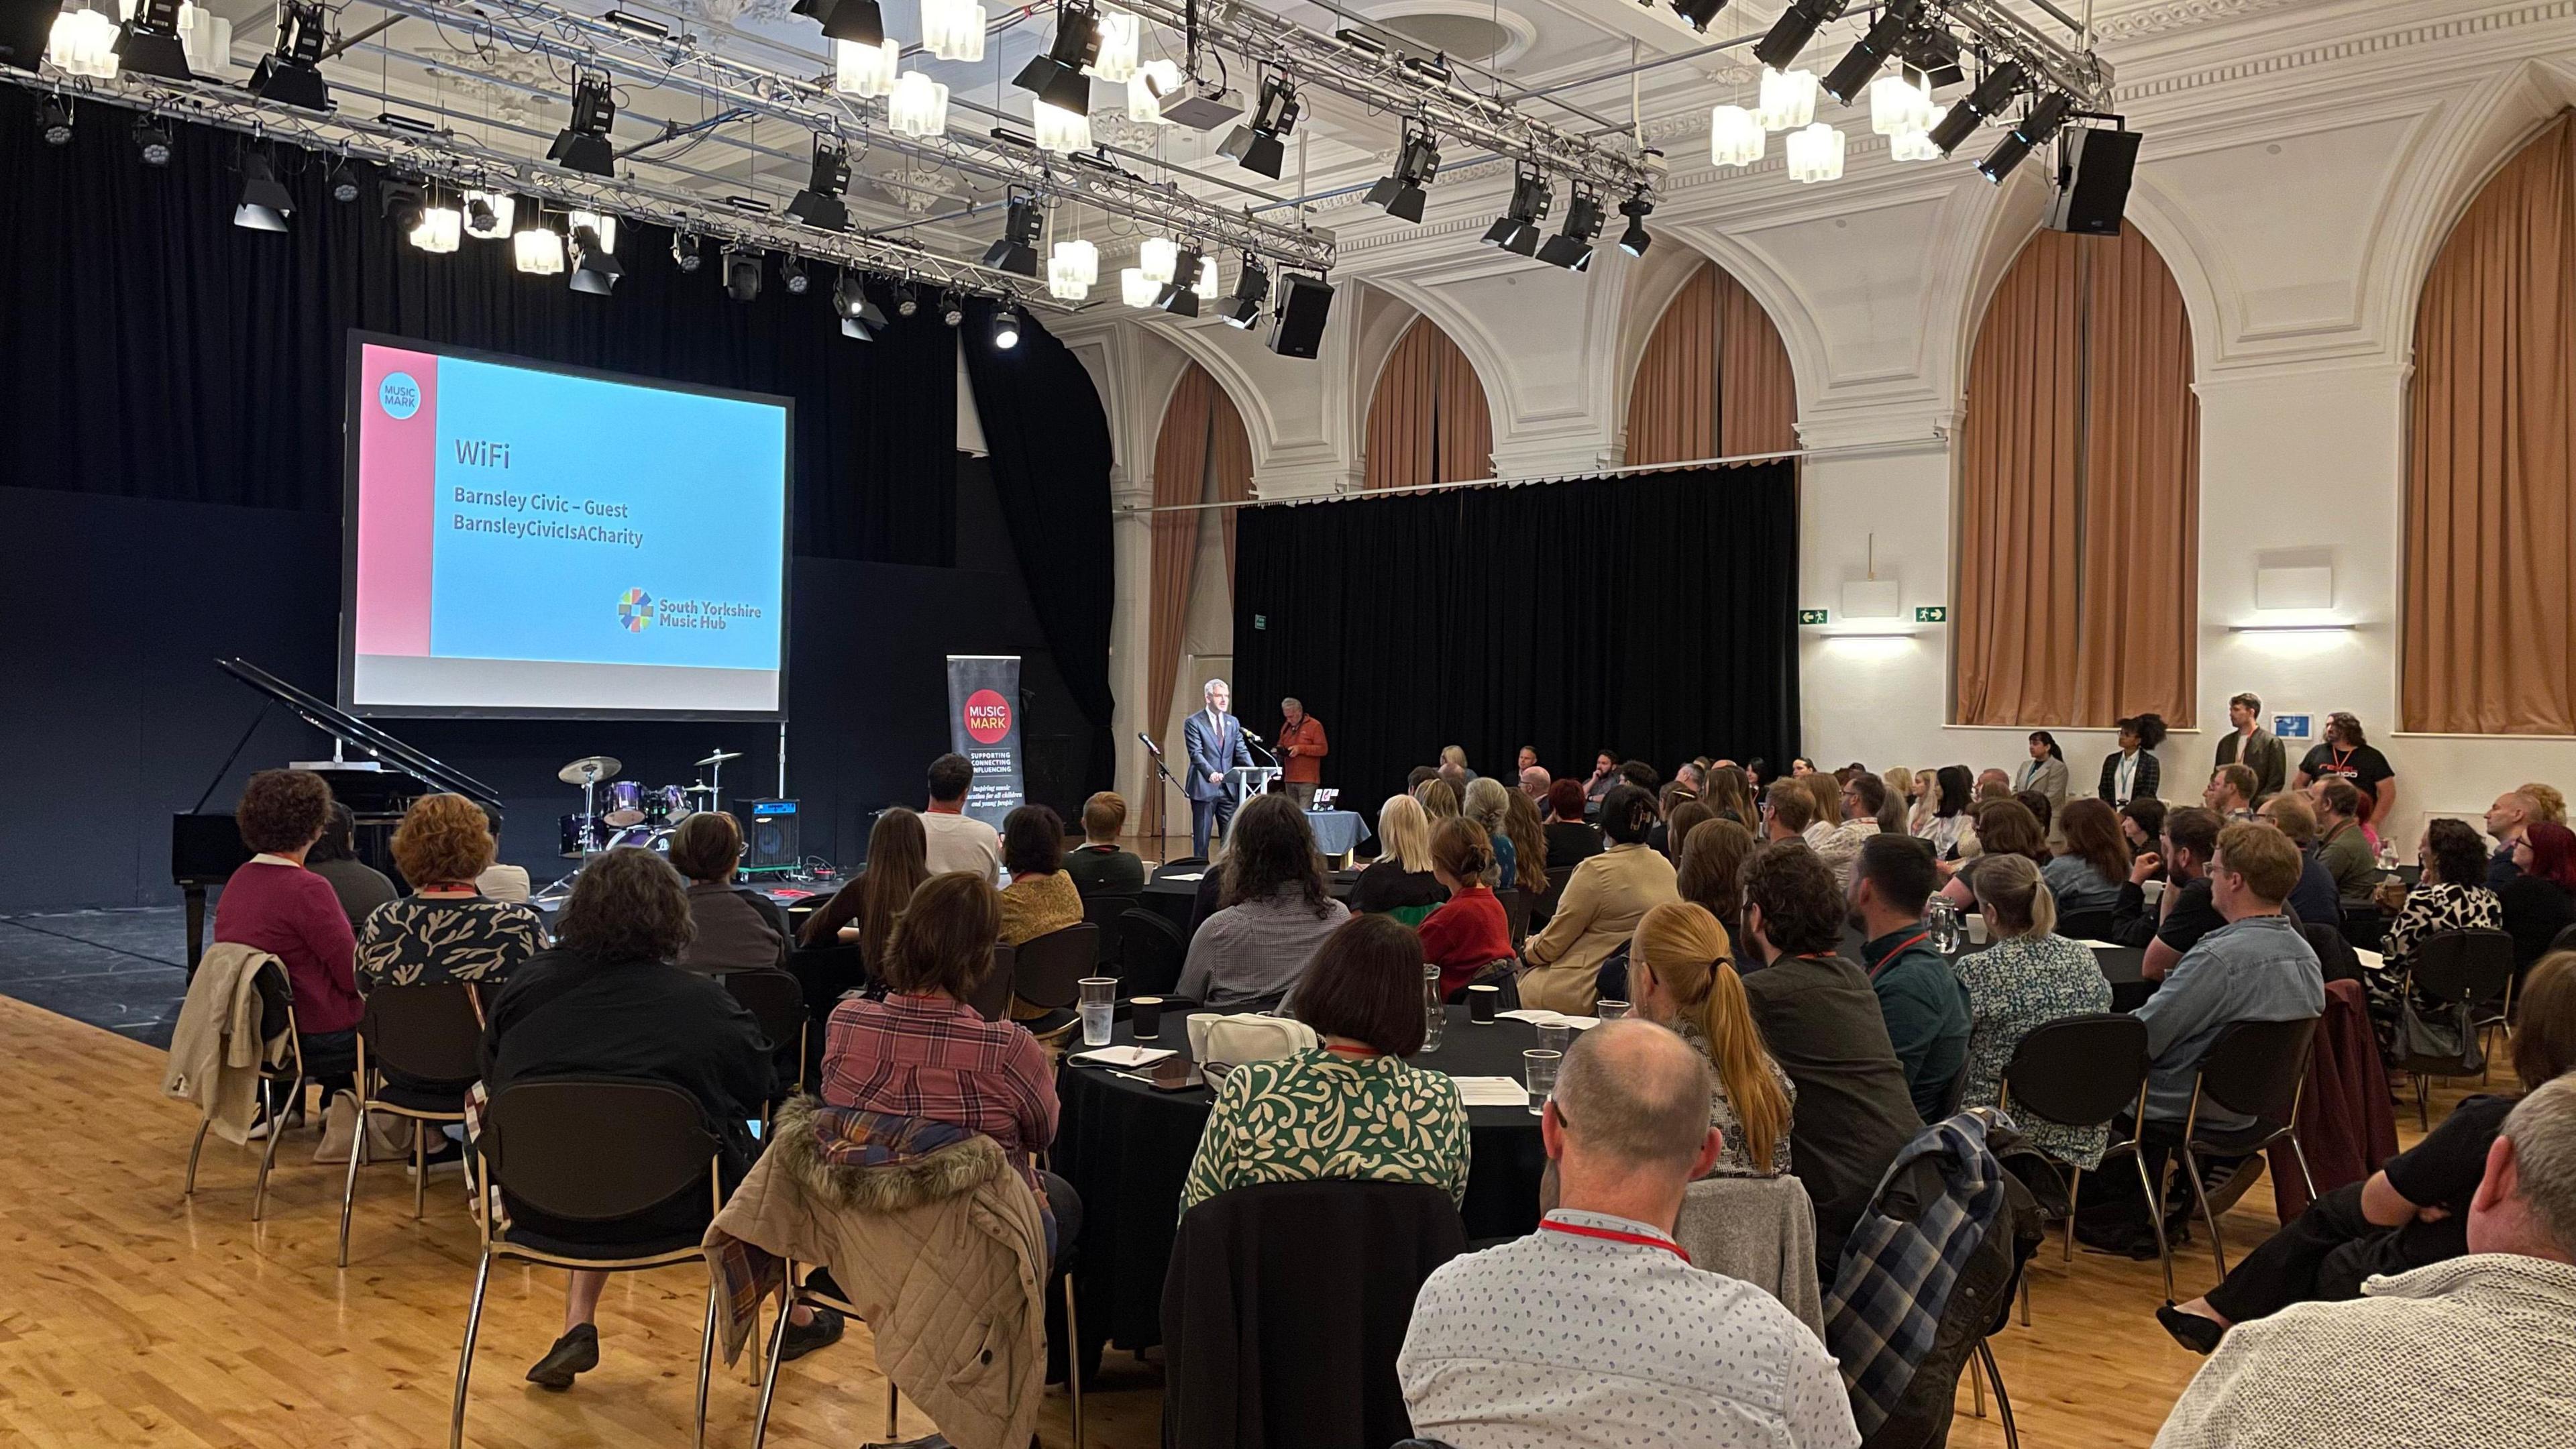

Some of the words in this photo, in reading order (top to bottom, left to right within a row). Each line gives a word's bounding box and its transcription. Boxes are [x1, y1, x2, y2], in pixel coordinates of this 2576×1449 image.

[385, 385, 415, 397] MUSIC
[385, 394, 415, 408] MARK
[455, 439, 510, 469] WiFi
[454, 486, 527, 512] Barnsley
[531, 494, 568, 512] Civic
[584, 500, 628, 519] Guest
[453, 514, 643, 549] BarnsleyCivicIsACharity
[660, 598, 698, 614] South
[702, 601, 761, 618] Yorkshire
[660, 613, 696, 628] Music
[700, 615, 726, 629] Hub
[969, 706, 1006, 716] MUSIC
[971, 717, 1006, 729] MARK
